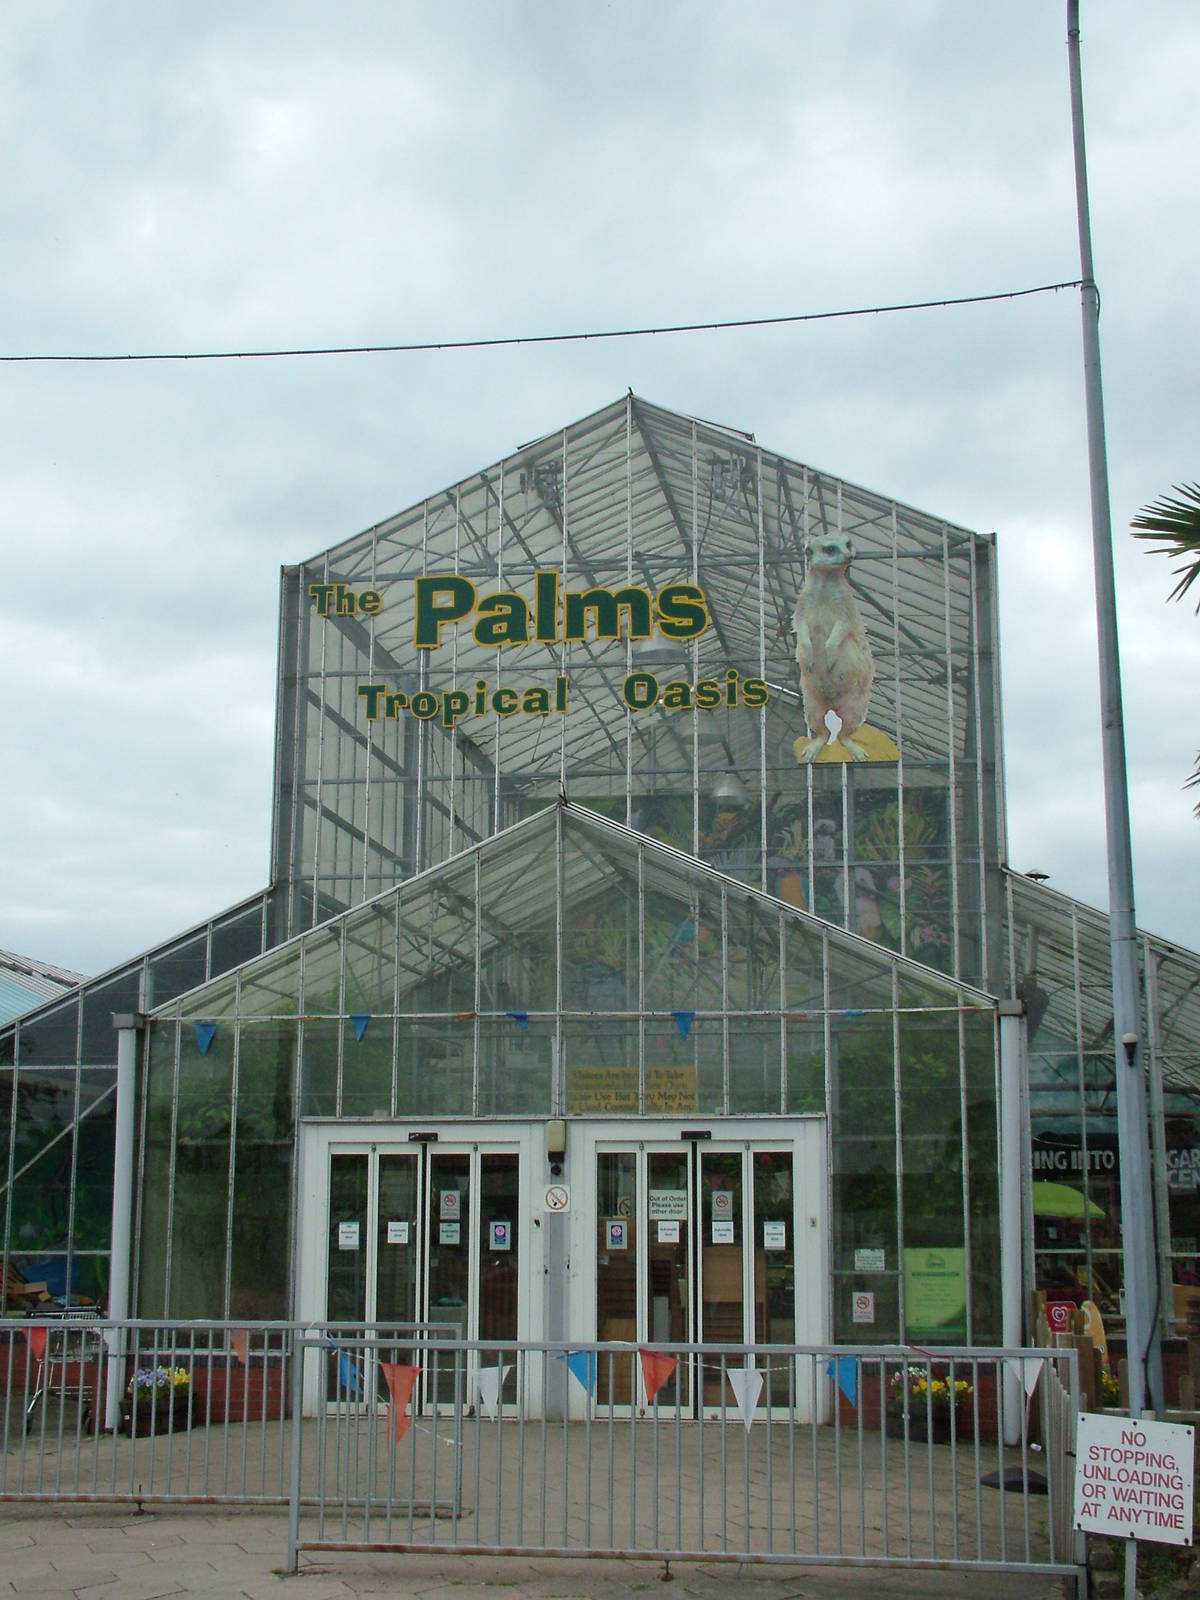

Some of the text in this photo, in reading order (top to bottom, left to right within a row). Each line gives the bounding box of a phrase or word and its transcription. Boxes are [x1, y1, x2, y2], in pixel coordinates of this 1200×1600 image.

[309, 569, 709, 649] The Palms
[358, 669, 769, 728] Tropical Oasis
[1033, 1151, 1067, 1169] ING
[1121, 1430, 1147, 1447] NO
[1088, 1445, 1179, 1473] STOPPING,
[1083, 1464, 1184, 1490] UNLOADING
[1082, 1483, 1184, 1510] OR WAITING
[1080, 1502, 1185, 1530] AT ANYTIME
